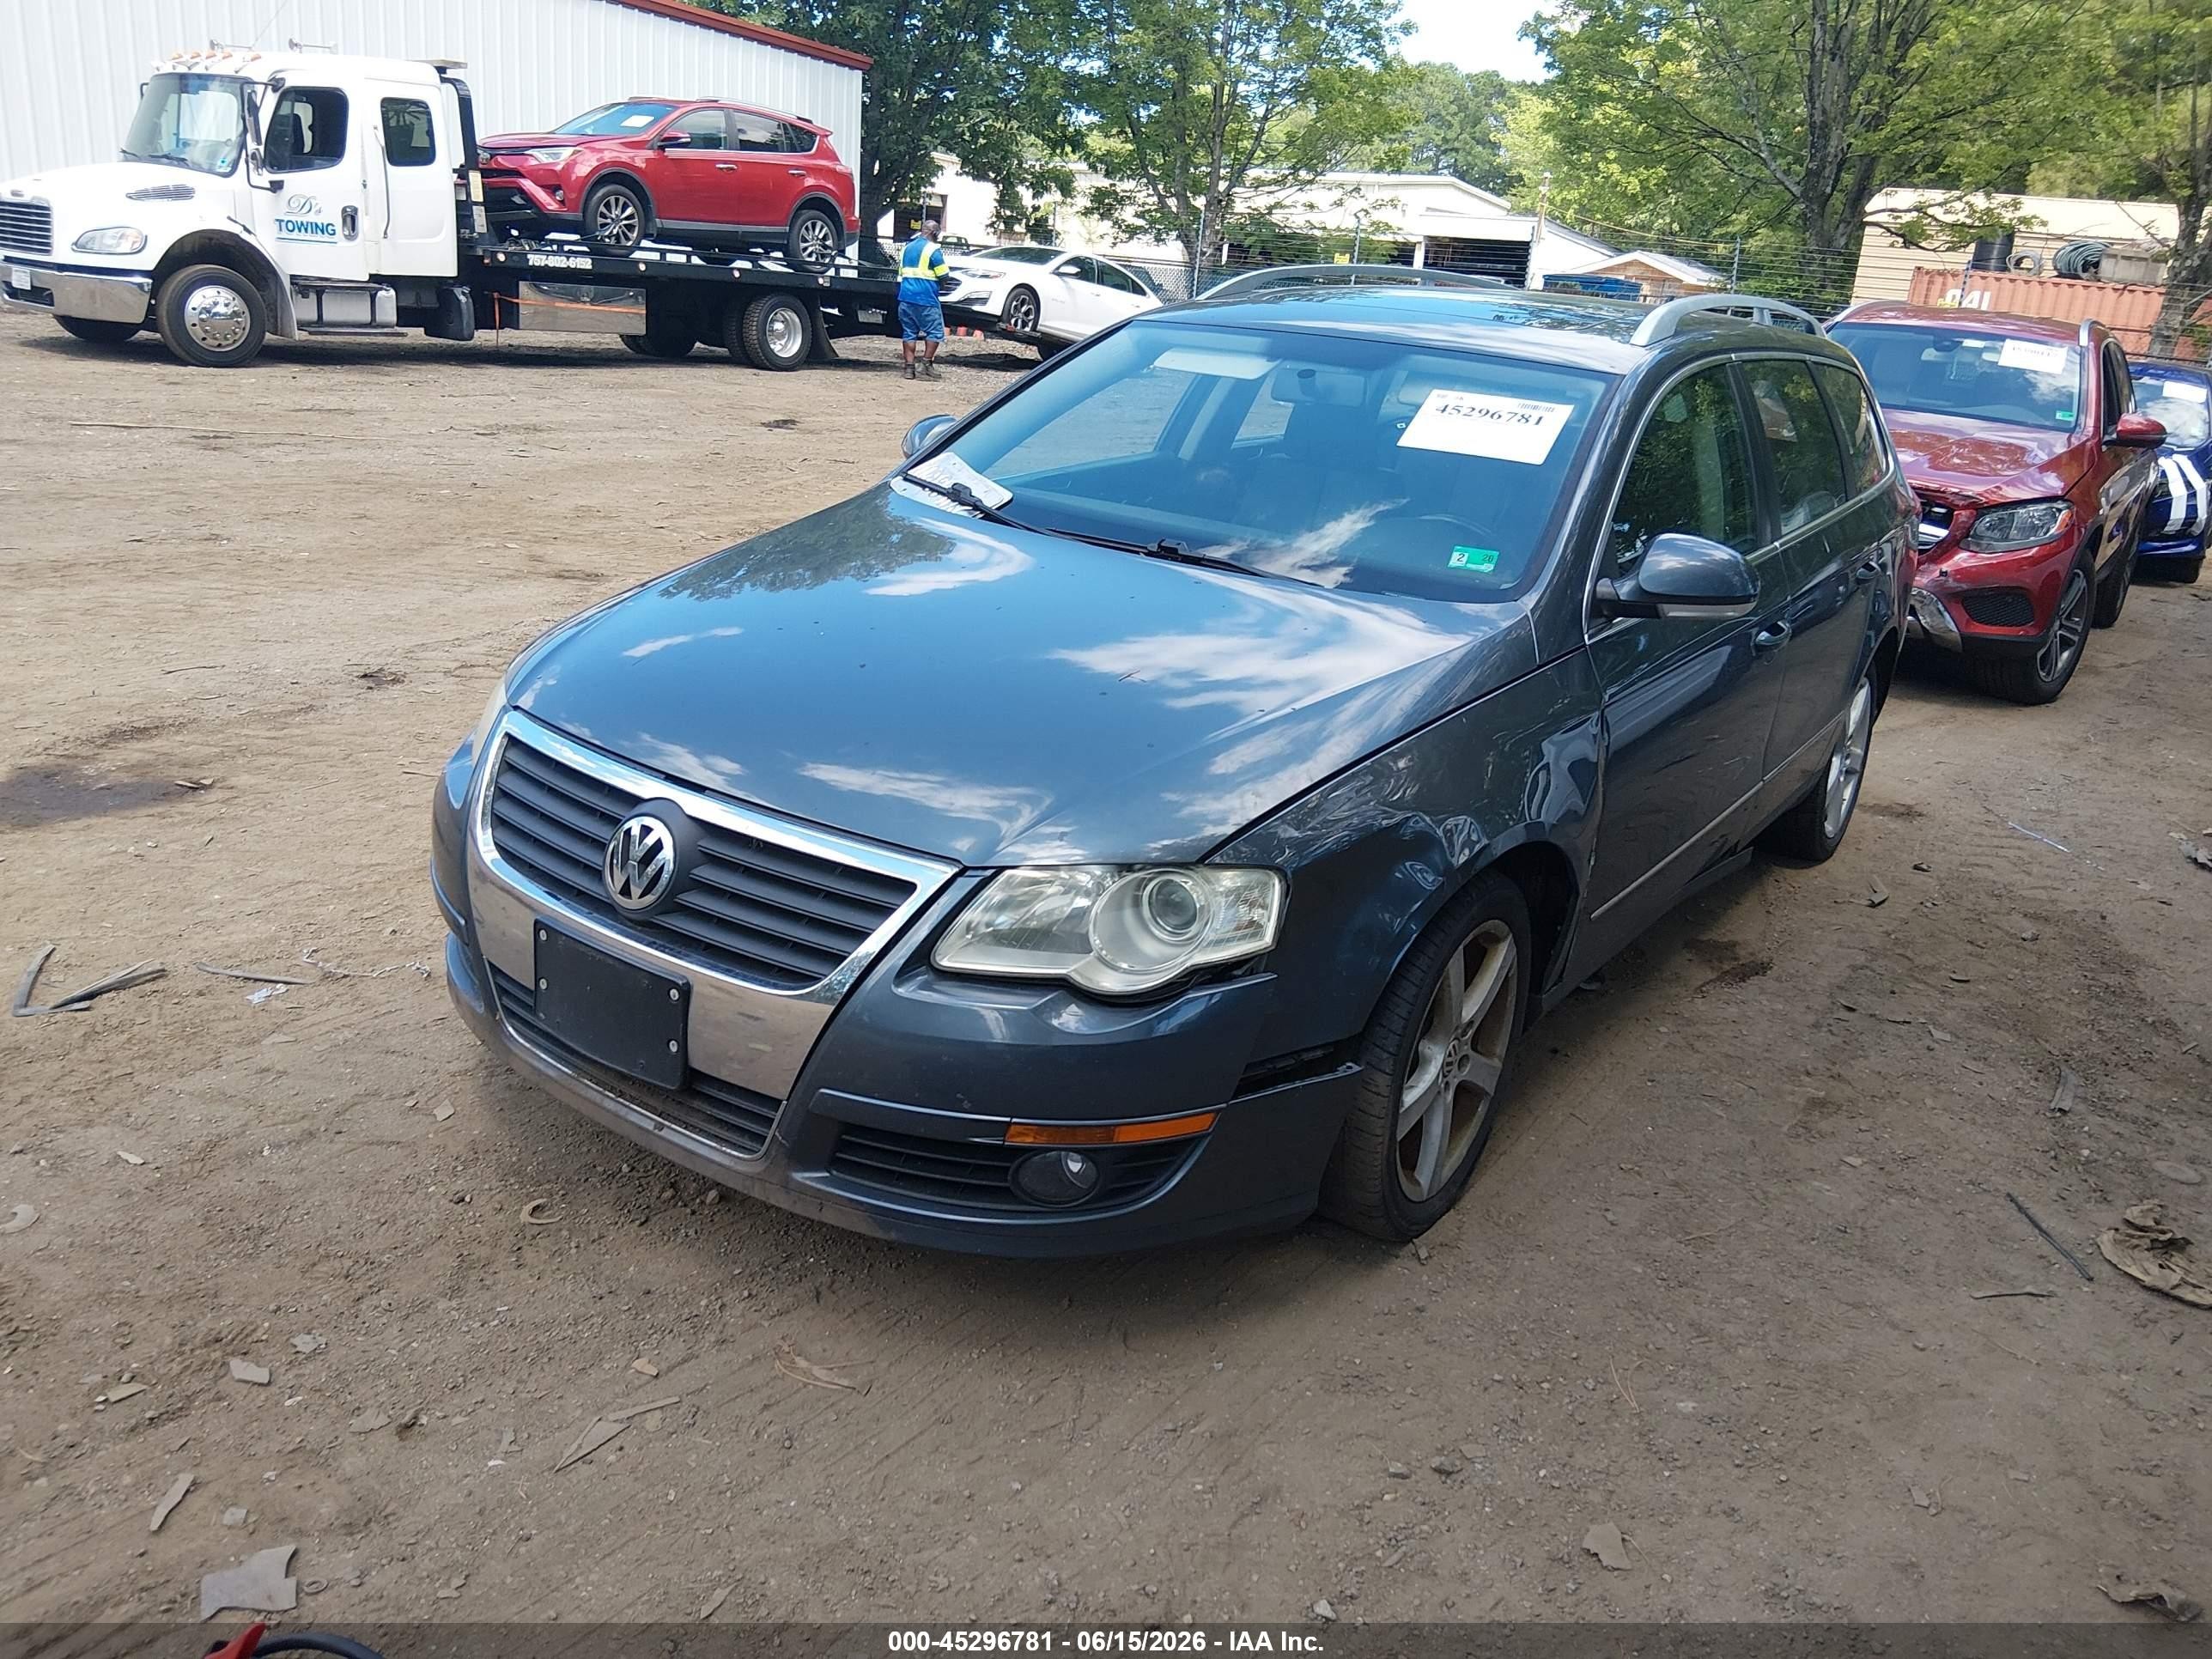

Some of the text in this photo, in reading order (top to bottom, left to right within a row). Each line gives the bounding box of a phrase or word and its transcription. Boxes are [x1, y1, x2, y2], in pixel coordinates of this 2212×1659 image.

[285, 193, 323, 216] D's
[275, 218, 337, 236] TOWING
[1436, 404, 1545, 426] 45296781
[1456, 552, 1466, 562] 2
